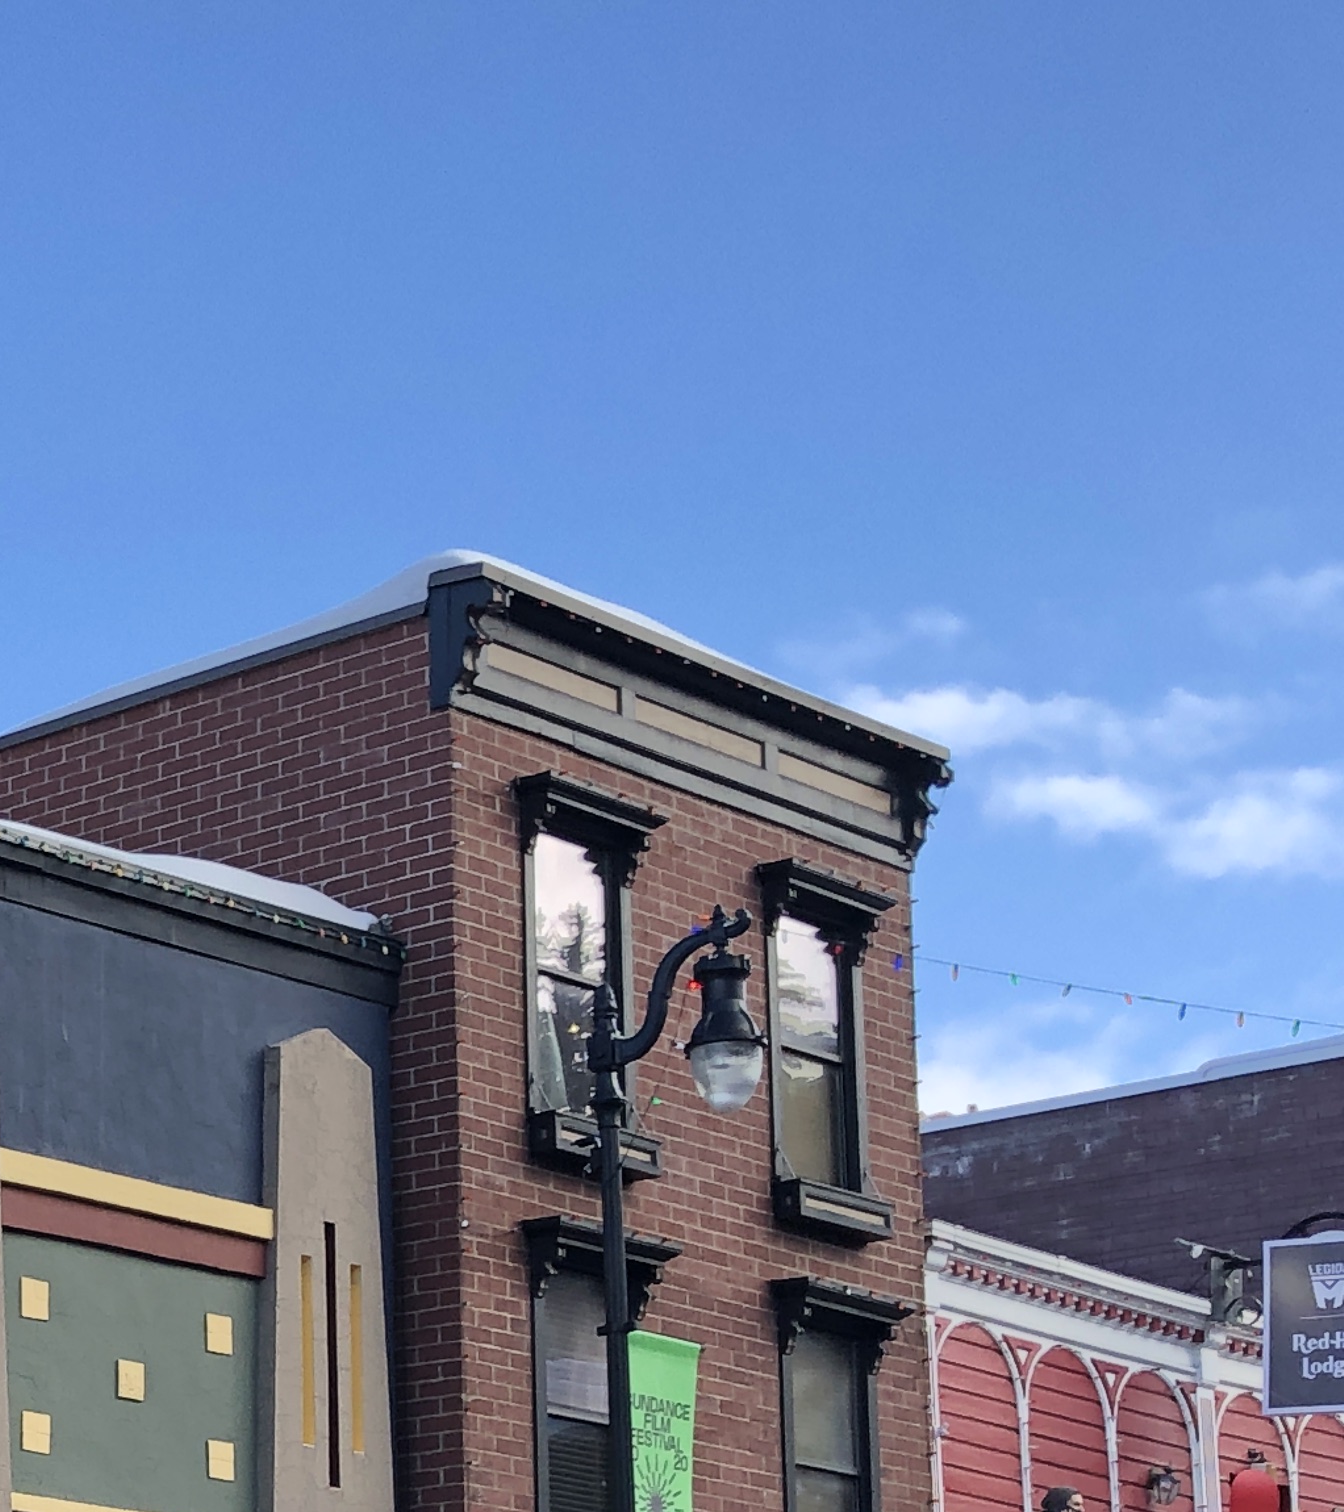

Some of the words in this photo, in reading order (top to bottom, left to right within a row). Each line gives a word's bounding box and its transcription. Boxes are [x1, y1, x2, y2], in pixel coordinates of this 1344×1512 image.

[1308, 1262, 1344, 1276] LEGIO
[631, 1392, 691, 1421] UNDANCE
[644, 1413, 672, 1434] FILM
[631, 1429, 684, 1455] FESTIVAL
[674, 1455, 688, 1472] 20
